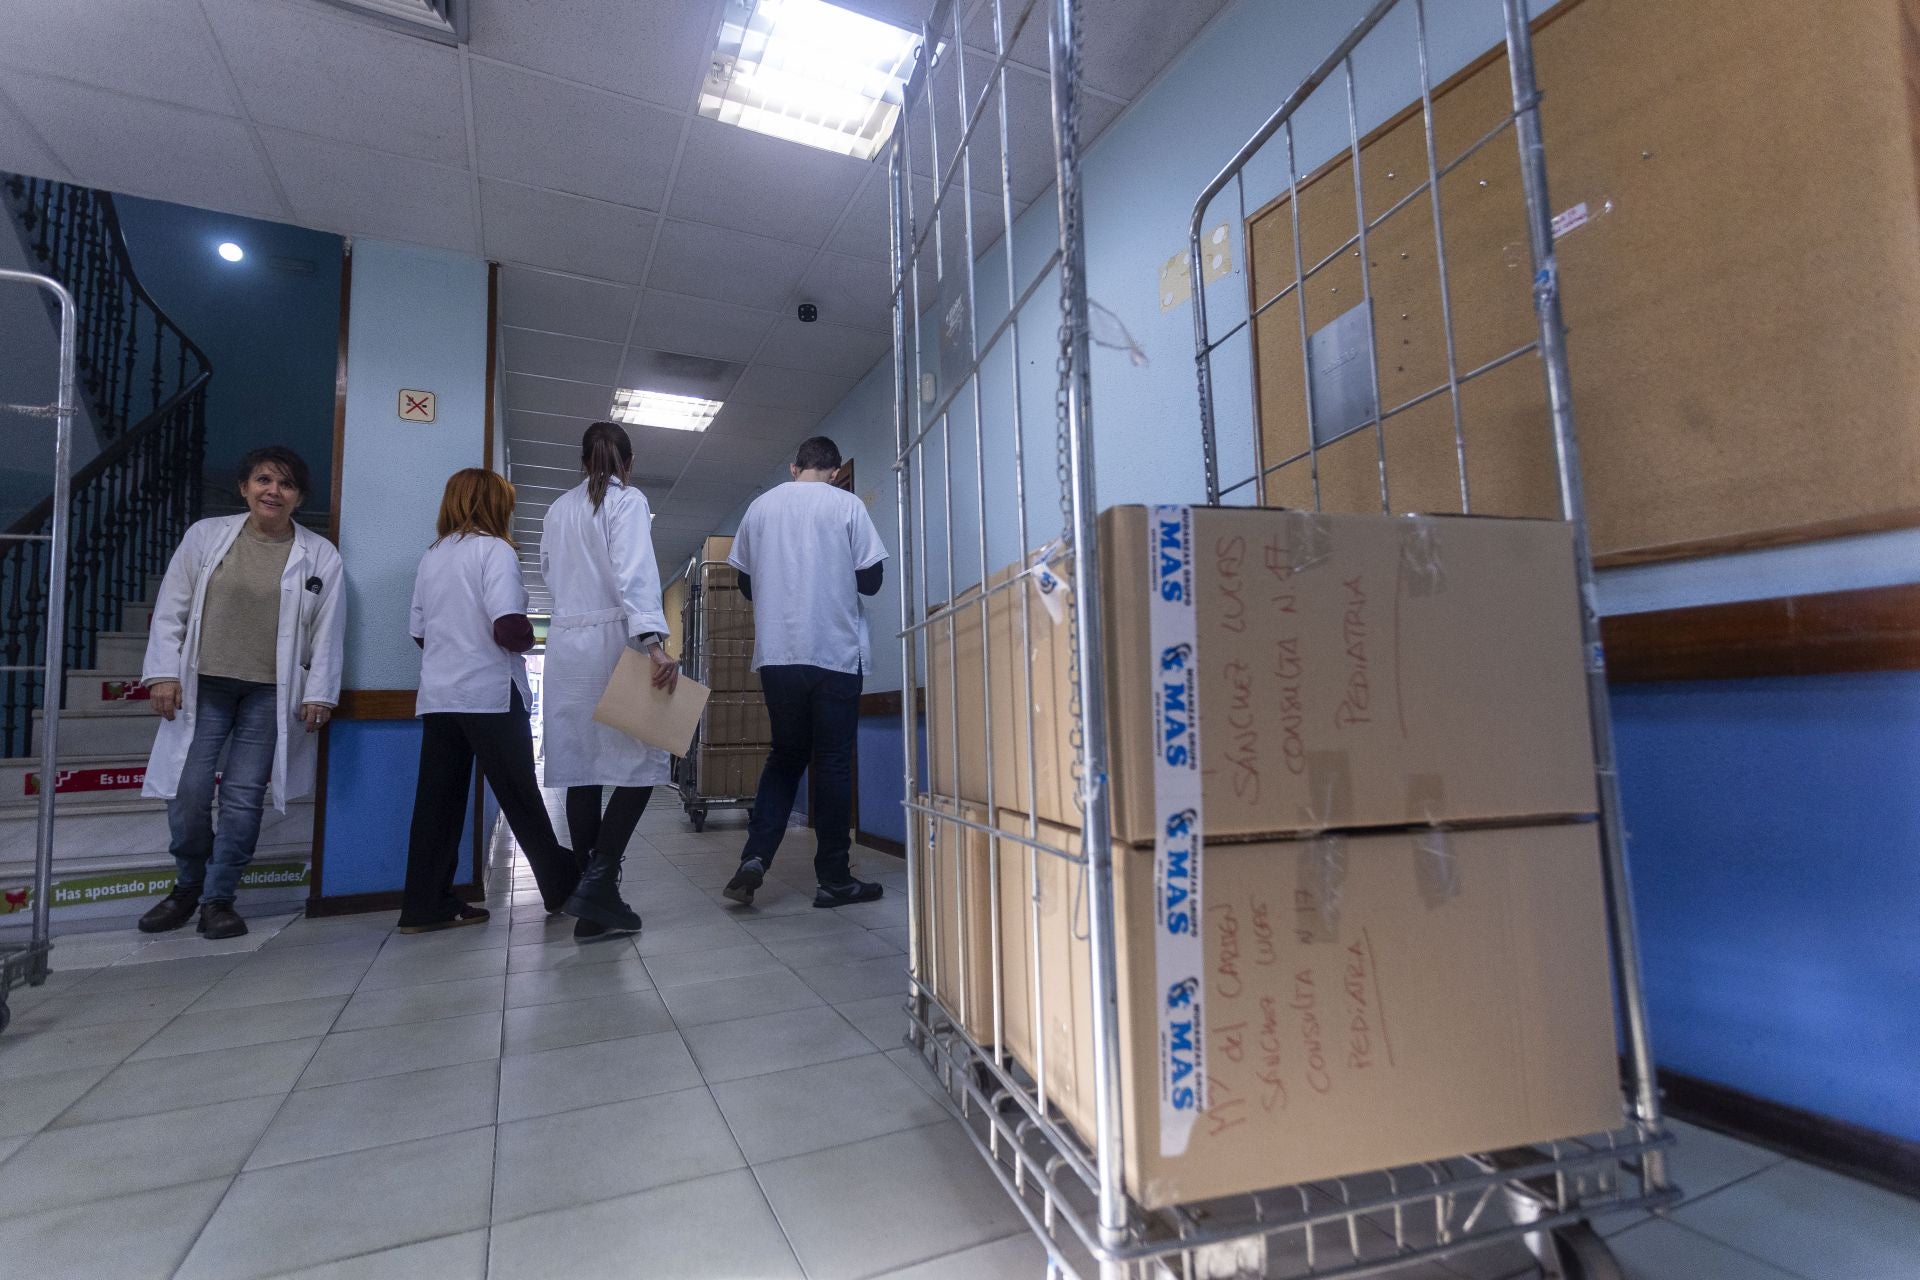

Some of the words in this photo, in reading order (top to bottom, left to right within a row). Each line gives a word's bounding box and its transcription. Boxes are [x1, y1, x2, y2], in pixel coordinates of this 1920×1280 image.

[1159, 521, 1183, 603] MAS
[1183, 568, 1192, 607] GRUPO
[1215, 535, 1246, 634] LUCAS
[1163, 683, 1188, 768] MAS
[1188, 731, 1197, 770] GRUPO
[100, 774, 113, 785] Es
[117, 773, 130, 784] tu
[133, 774, 145, 783] sa
[55, 888, 81, 902] Has
[85, 880, 145, 900] apostado
[148, 879, 171, 893] por
[1166, 850, 1190, 935] MAS
[1294, 887, 1316, 912] 17
[1190, 898, 1199, 938] GRUPO
[1250, 893, 1278, 967] LUCAS
[1212, 1021, 1248, 1063] del
[1170, 1020, 1194, 1110] MAS
[1194, 1071, 1203, 1113] GRUPO
